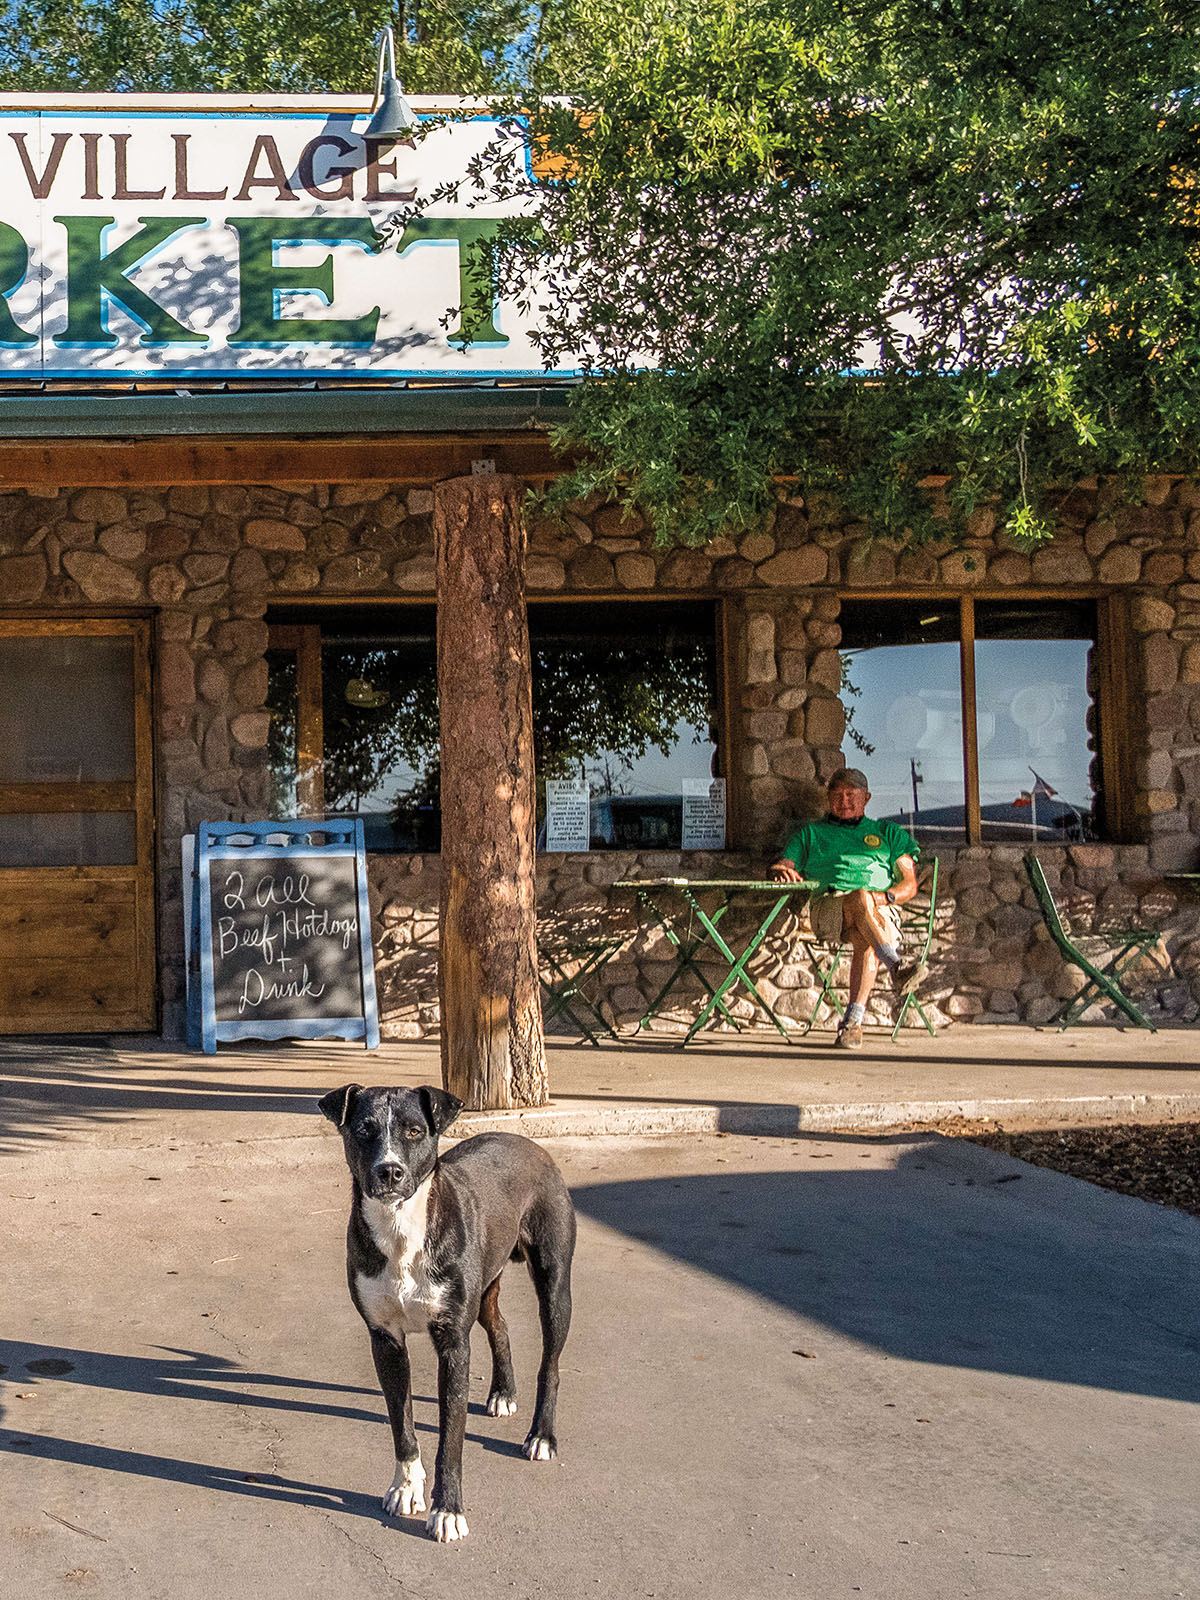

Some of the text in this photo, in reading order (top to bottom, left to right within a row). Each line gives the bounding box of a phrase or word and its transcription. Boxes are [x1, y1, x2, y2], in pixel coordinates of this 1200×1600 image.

[8, 132, 418, 201] VILLAGE
[224, 871, 246, 910] 2
[218, 914, 278, 965] Beef
